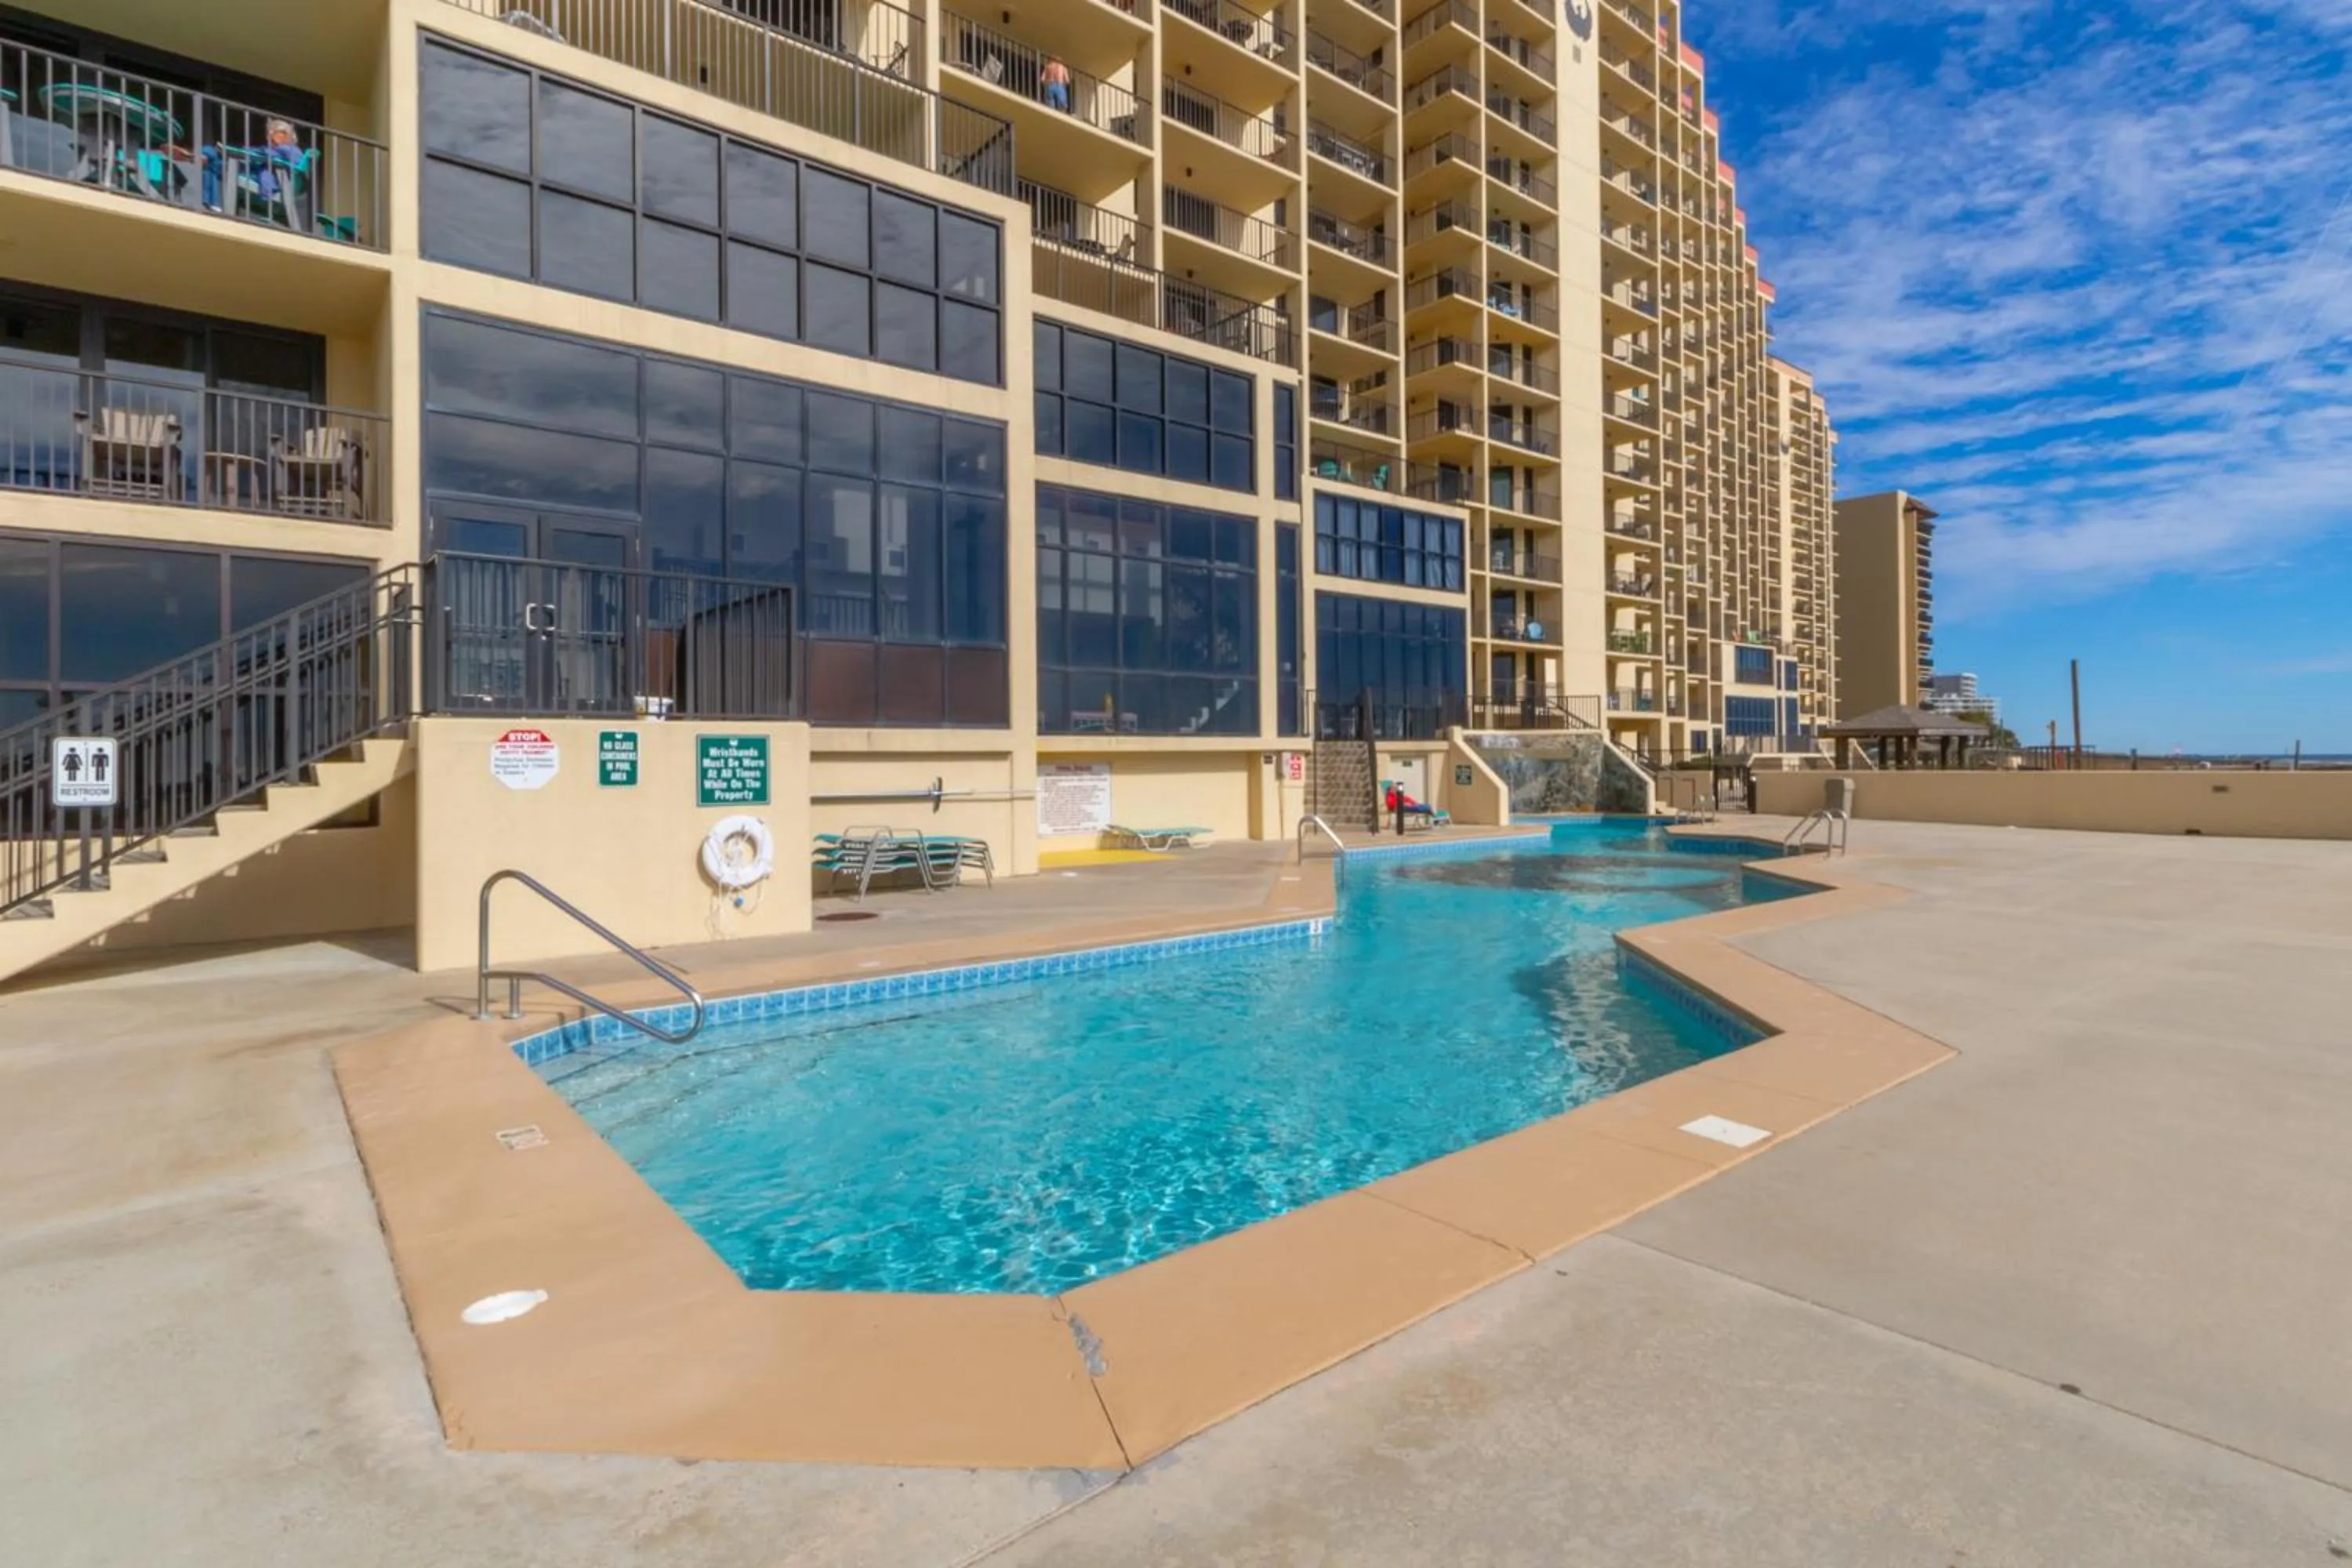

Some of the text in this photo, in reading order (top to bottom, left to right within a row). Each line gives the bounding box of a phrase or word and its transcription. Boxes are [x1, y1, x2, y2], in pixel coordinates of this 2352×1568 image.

[507, 732, 541, 742] STOP!
[603, 741, 634, 750] NO GLASS
[600, 751, 637, 760] CONTAINERS
[709, 746, 758, 757] Wristbands
[606, 761, 631, 771] IN POOL
[702, 757, 764, 768] Must Be Worn
[610, 771, 627, 782] AREA
[707, 768, 760, 779] At All Times
[703, 779, 761, 789] While On The
[60, 788, 110, 797] RESTROOM
[714, 789, 753, 802] Property
